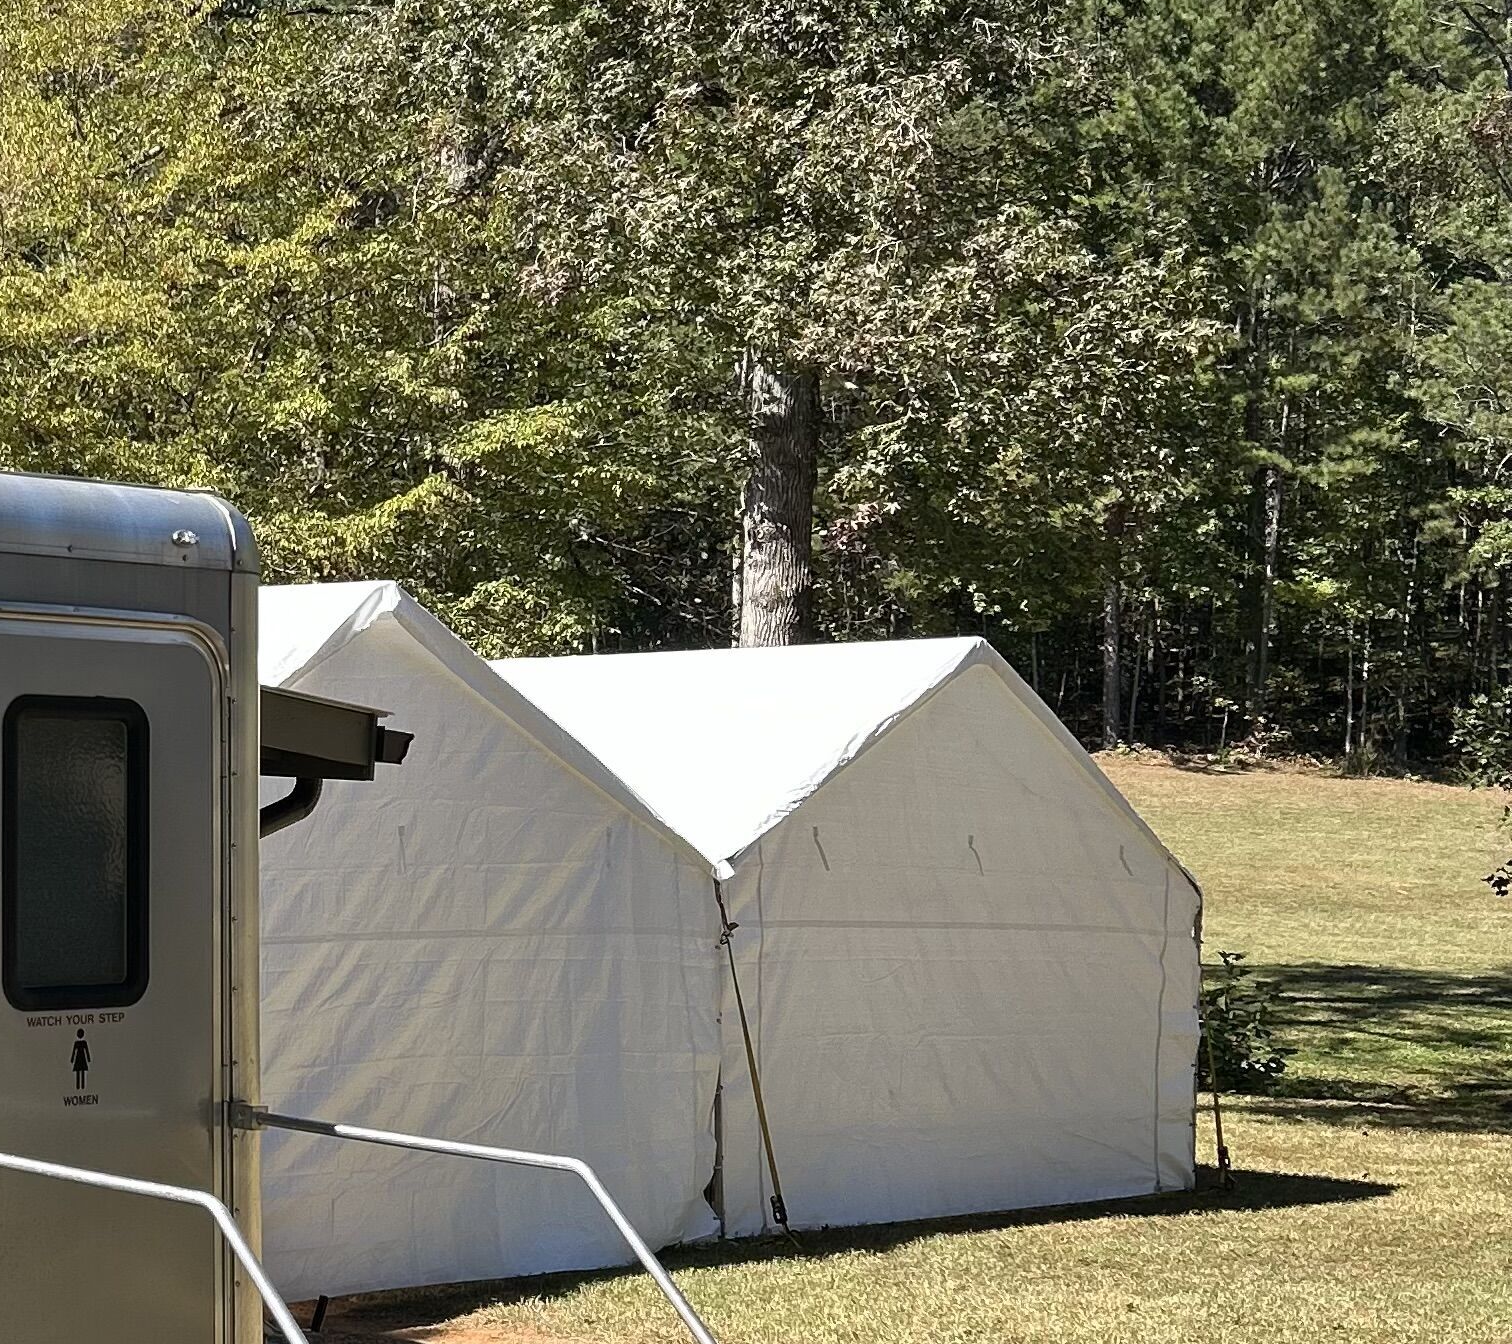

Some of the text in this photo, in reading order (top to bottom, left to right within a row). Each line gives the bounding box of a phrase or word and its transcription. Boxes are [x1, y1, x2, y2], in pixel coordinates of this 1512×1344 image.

[26, 1012, 125, 1027] WATCH YOUR STEP
[63, 1094, 99, 1107] WOMEN
